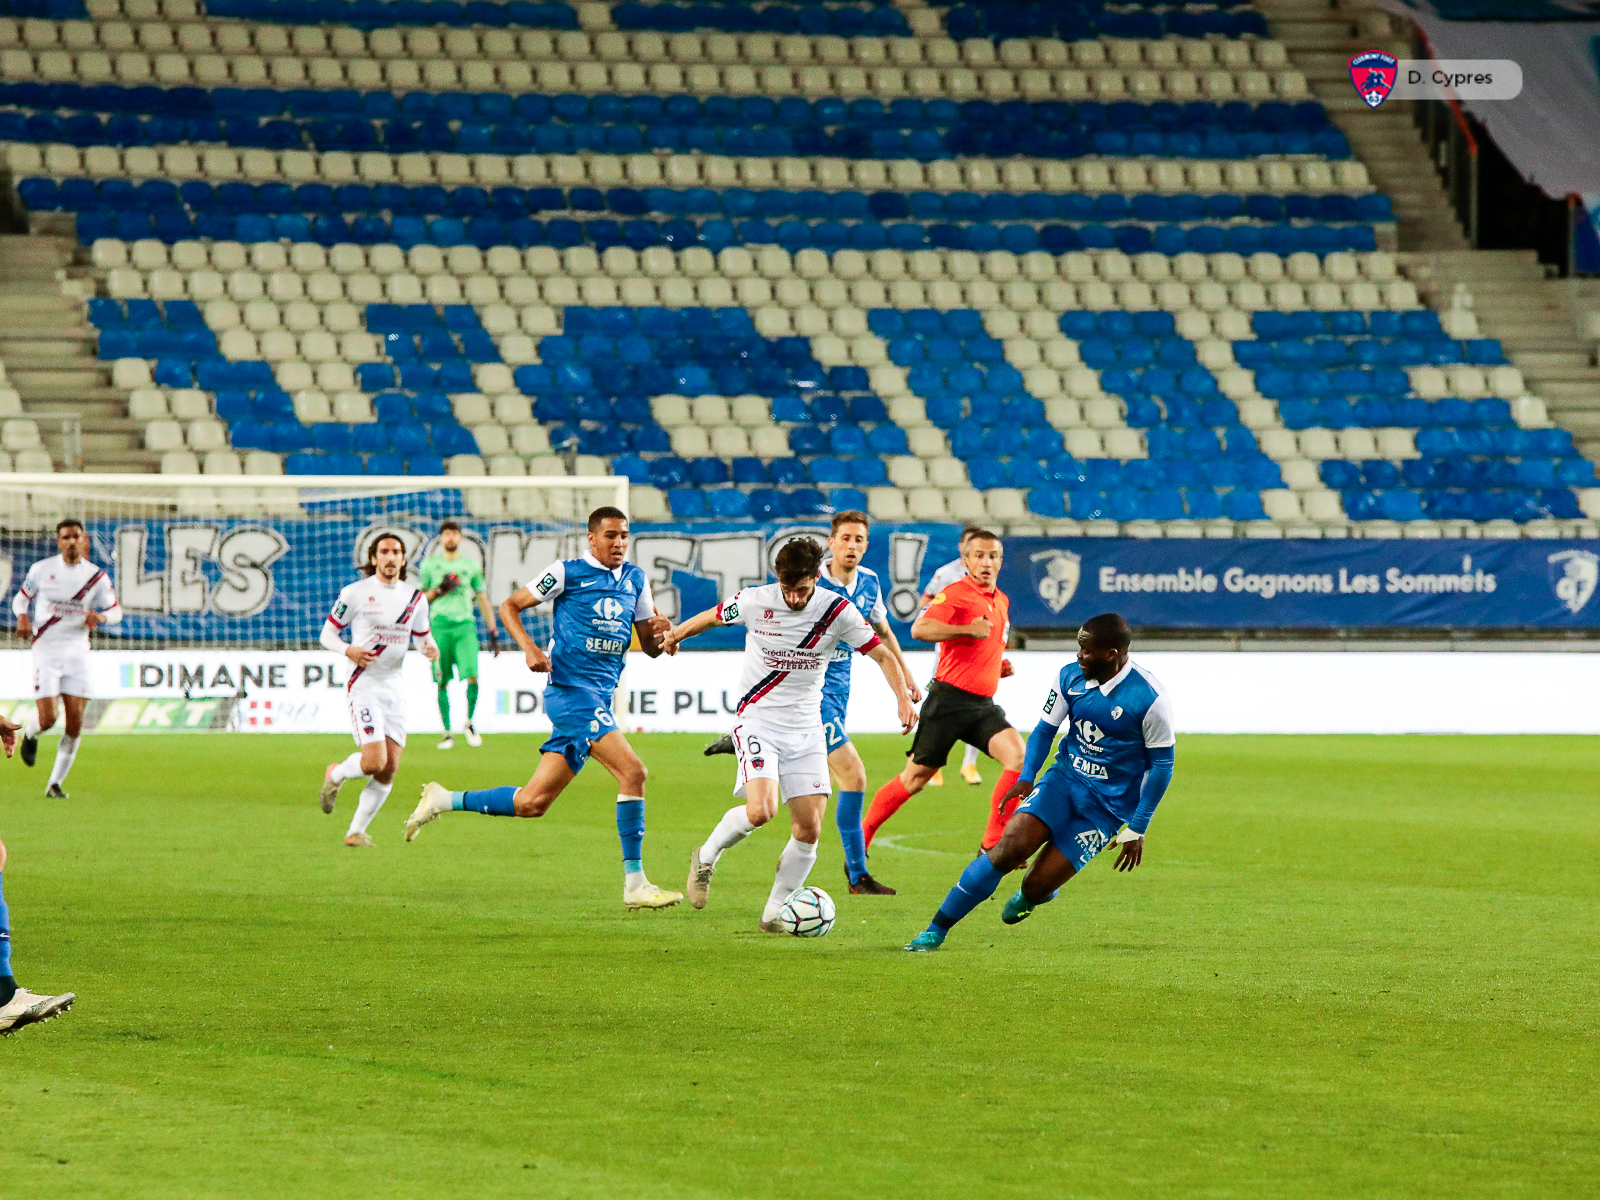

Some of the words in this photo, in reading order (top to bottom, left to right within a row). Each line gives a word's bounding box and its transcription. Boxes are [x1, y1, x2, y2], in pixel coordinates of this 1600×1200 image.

[114, 524, 290, 618] LES
[1099, 567, 1218, 593] Ensemble
[1222, 567, 1334, 600] Gagnons
[1338, 567, 1380, 594] Les
[1385, 564, 1498, 594] Sommets
[585, 637, 624, 652] SEMPA
[761, 647, 787, 657] Crédit
[139, 663, 287, 689] DIMANE
[100, 700, 218, 728] BKT
[360, 707, 372, 723] 8
[593, 706, 614, 727] 6
[747, 734, 762, 755] 6
